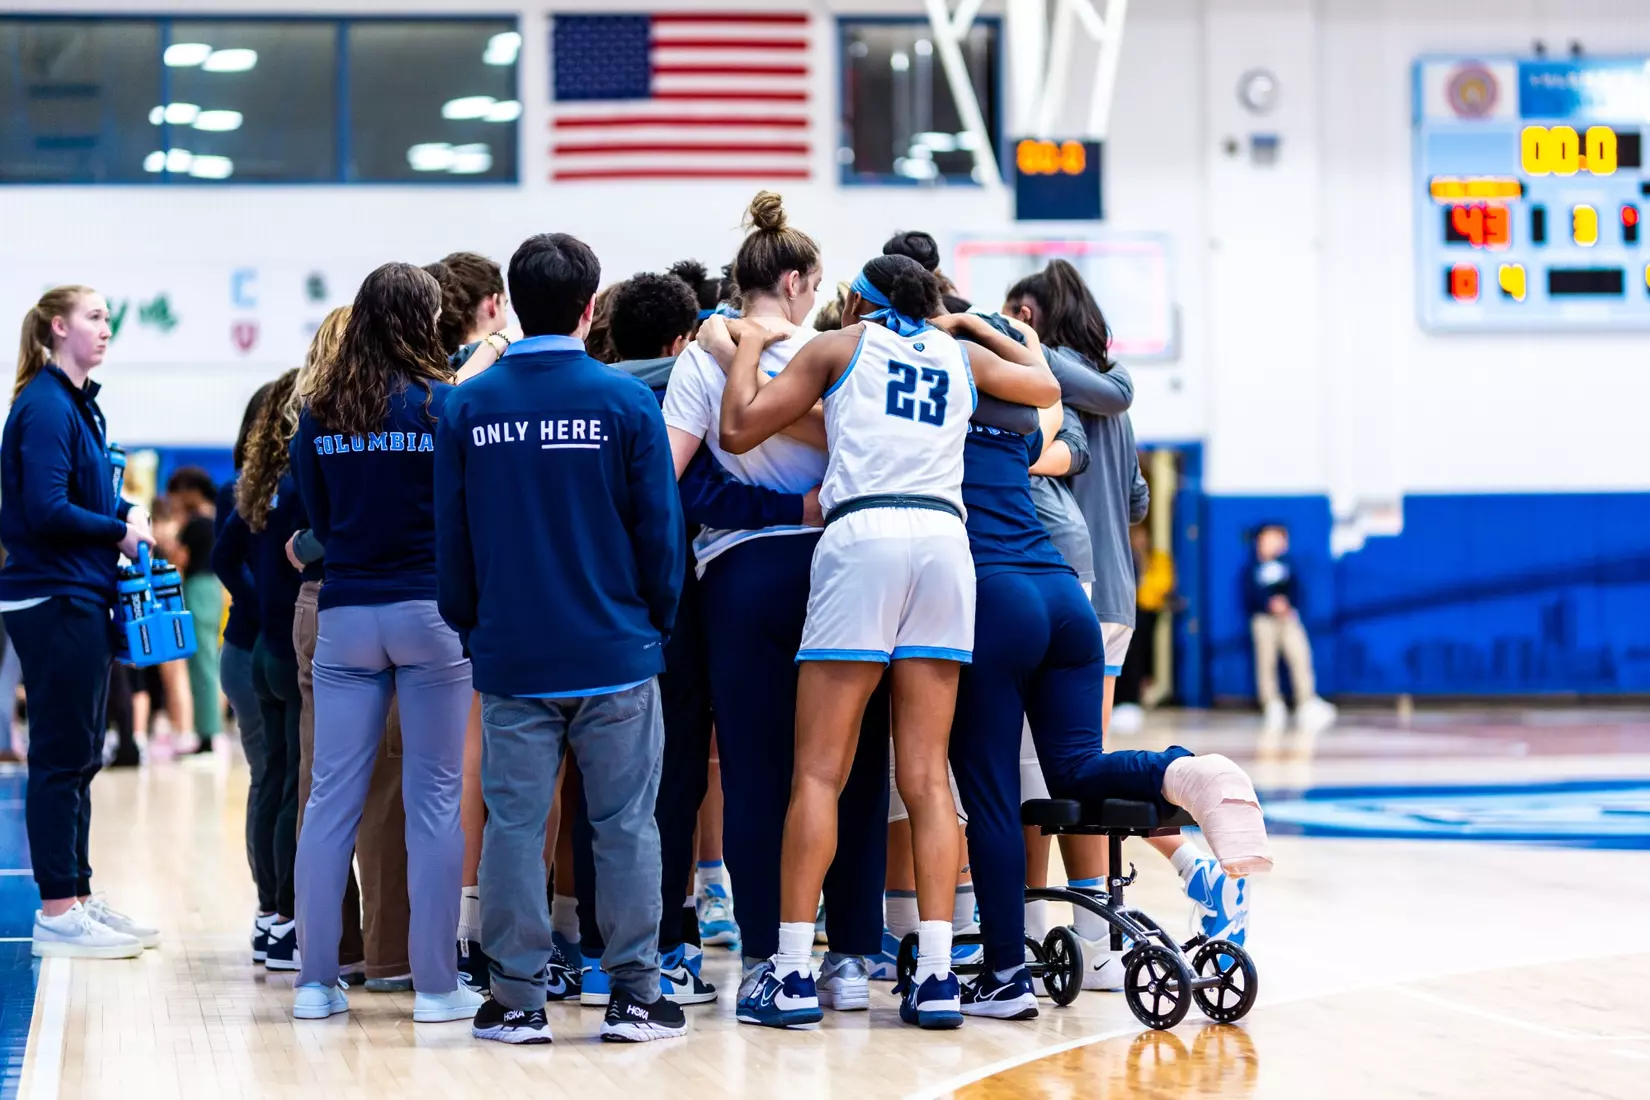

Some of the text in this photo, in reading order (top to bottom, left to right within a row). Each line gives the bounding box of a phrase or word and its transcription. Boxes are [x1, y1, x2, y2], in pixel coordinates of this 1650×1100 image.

[884, 358, 949, 428] 23
[313, 431, 434, 455] COLUMBIA
[472, 419, 609, 447] ONLY HERE.
[503, 1009, 525, 1022] HOKA
[626, 1004, 649, 1021] HOKA
